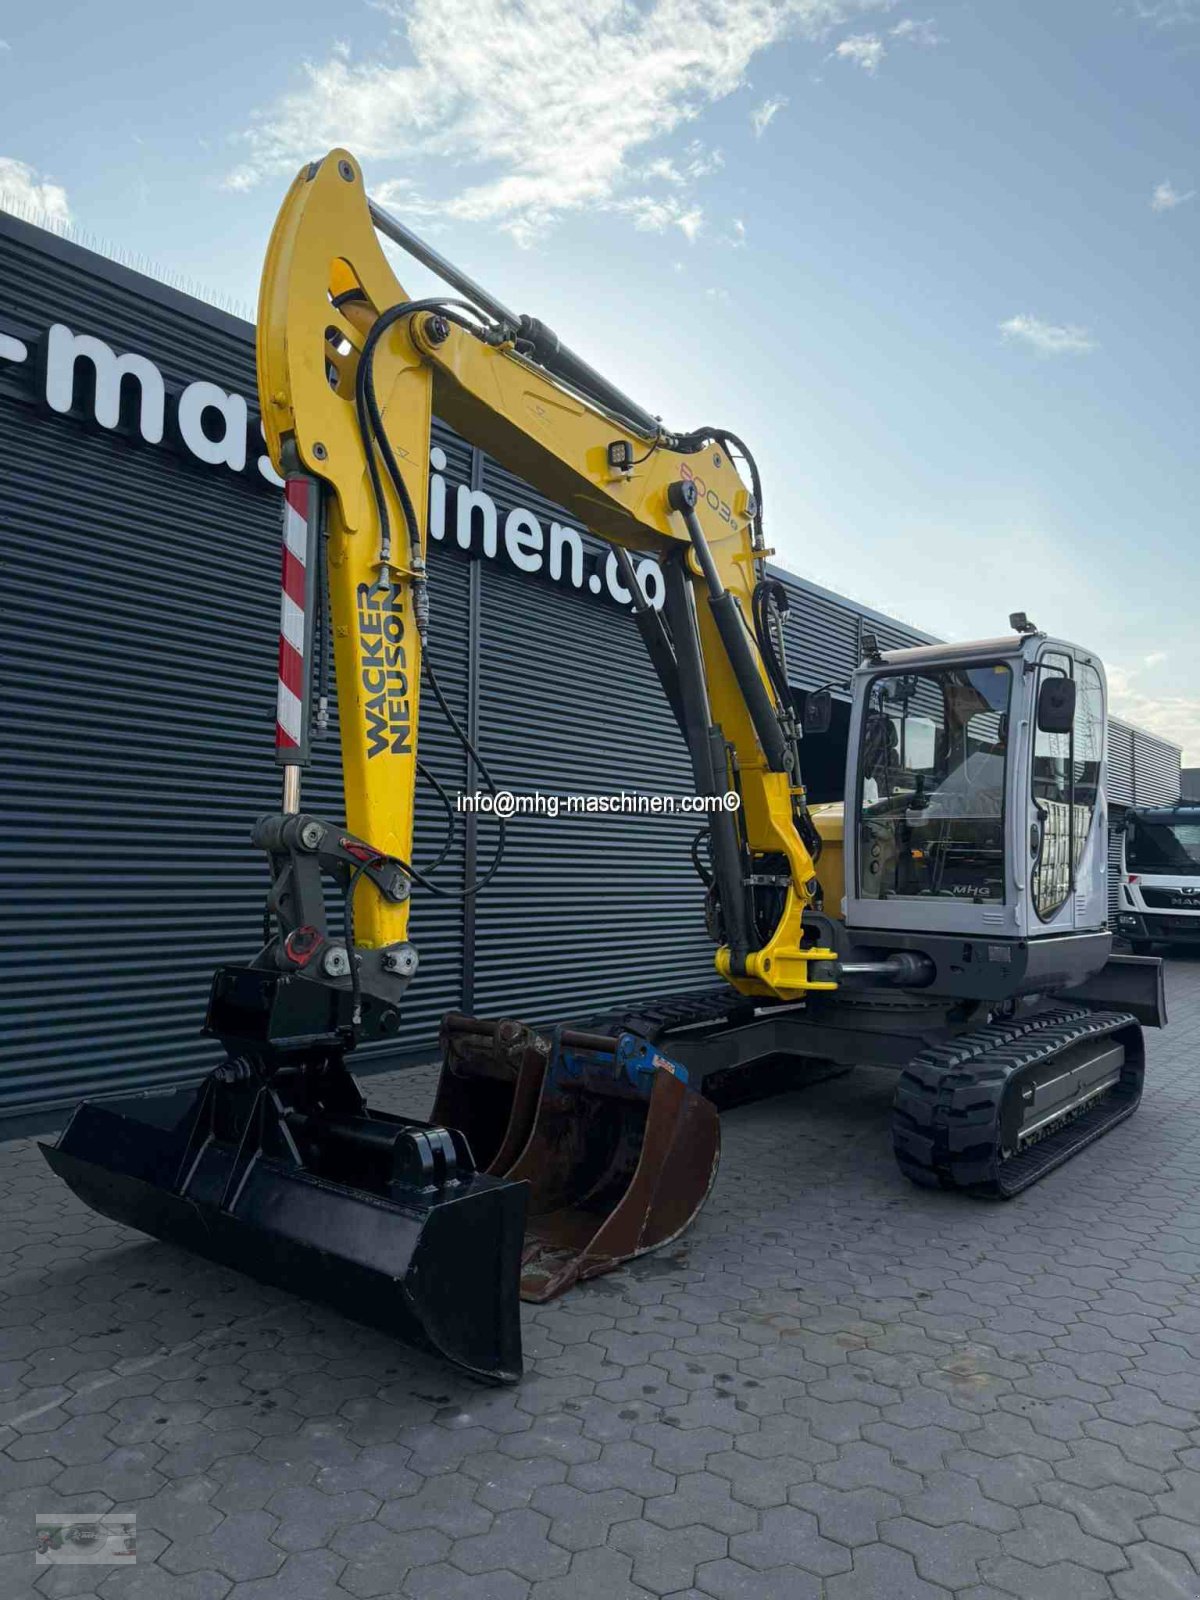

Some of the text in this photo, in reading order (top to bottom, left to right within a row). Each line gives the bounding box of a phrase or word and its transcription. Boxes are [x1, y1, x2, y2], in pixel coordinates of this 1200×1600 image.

[357, 582, 389, 759] WACKER
[381, 583, 412, 754] NEUSON
[953, 885, 991, 896] MHG
